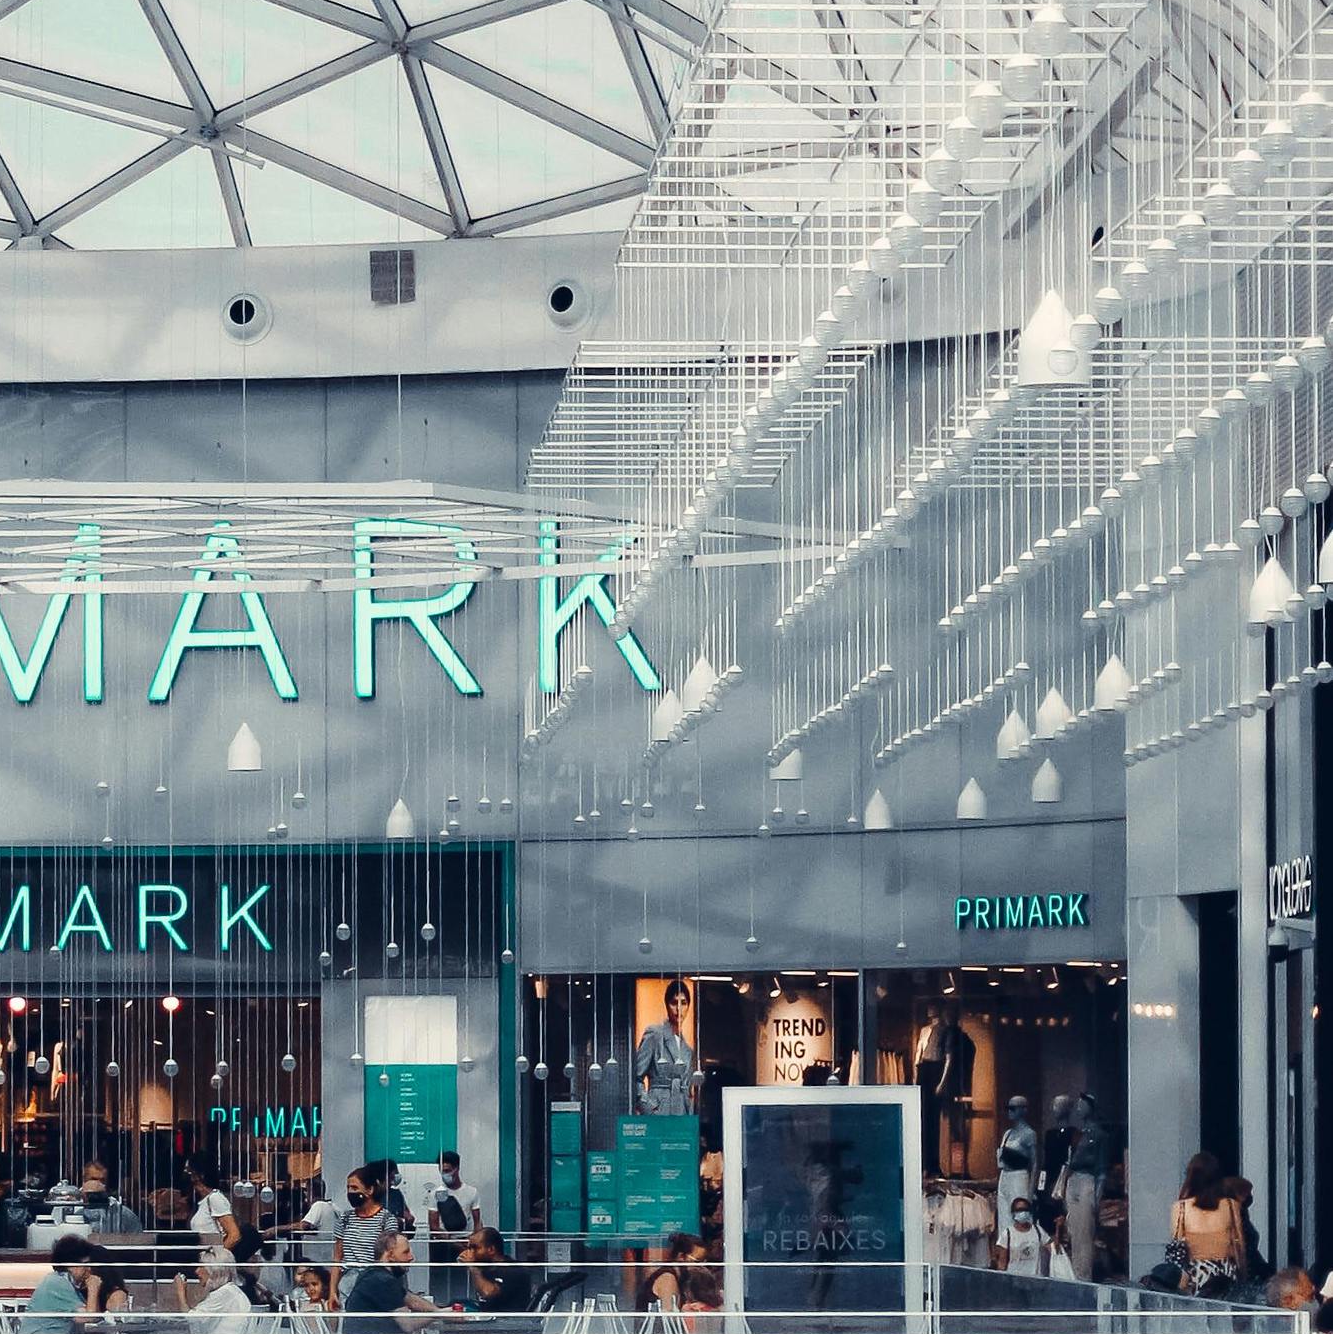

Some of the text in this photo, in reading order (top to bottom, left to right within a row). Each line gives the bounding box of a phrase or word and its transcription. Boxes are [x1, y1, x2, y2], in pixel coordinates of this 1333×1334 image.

[955, 893, 1087, 931] PRIMARK
[773, 1018, 826, 1037] TREND
[775, 1041, 806, 1059] ING
[774, 1063, 804, 1082] NO
[763, 1229, 886, 1252] REBAIXES
